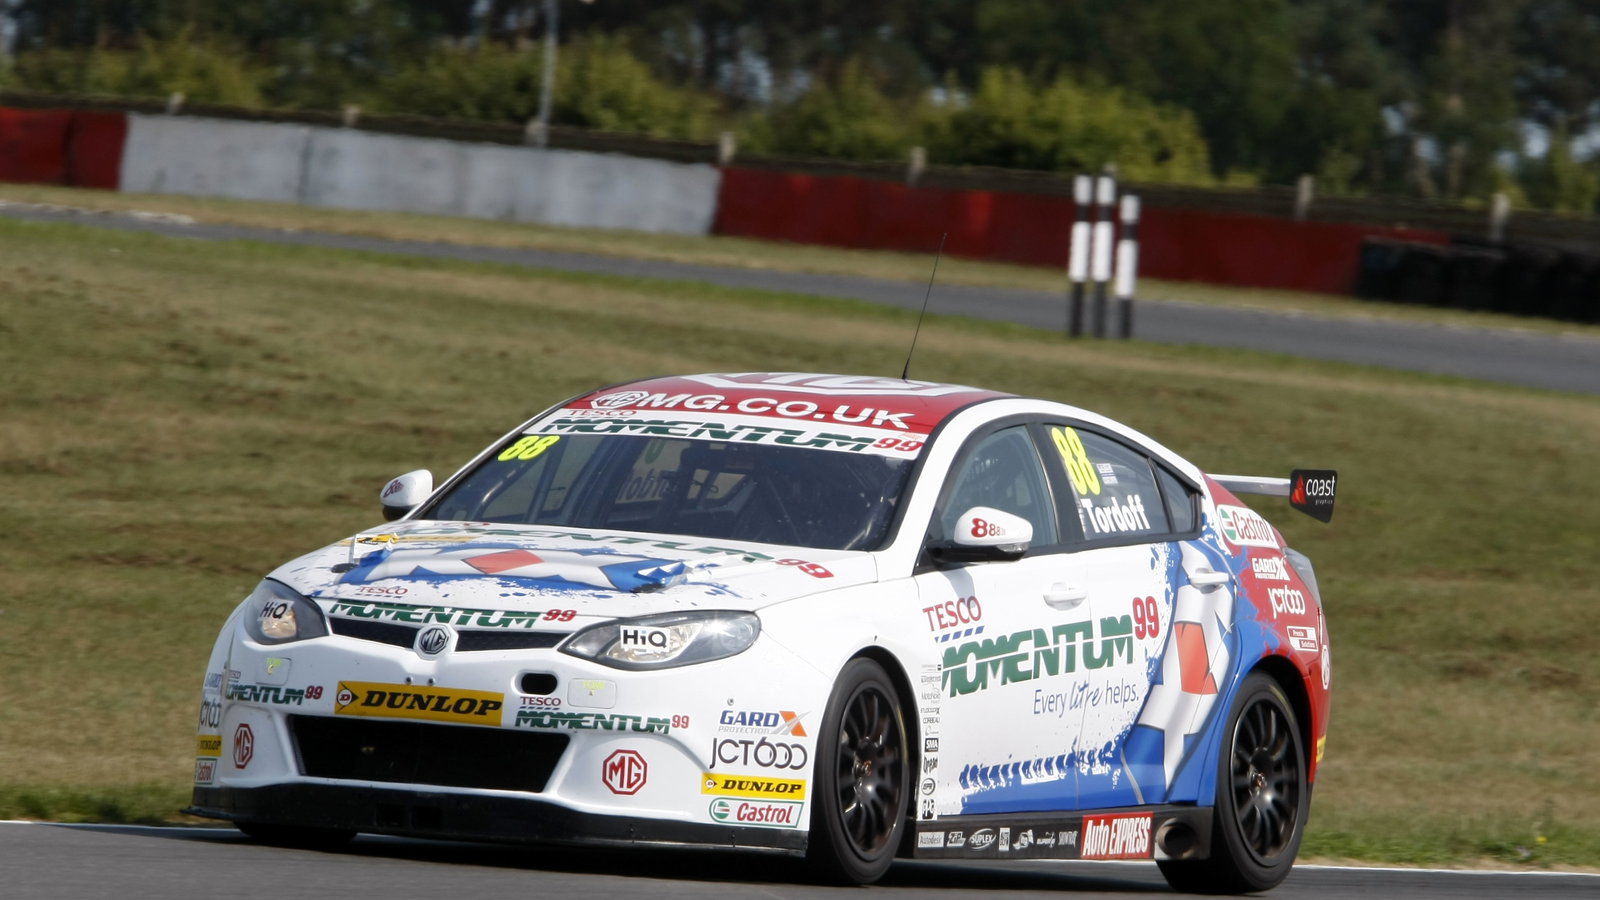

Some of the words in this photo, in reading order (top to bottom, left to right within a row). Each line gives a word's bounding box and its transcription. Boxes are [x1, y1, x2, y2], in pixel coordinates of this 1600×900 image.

[568, 409, 637, 417] TESCO
[640, 393, 916, 429] MG.CO.UK
[498, 435, 560, 461] 88
[539, 418, 877, 452] MOMENTUM
[872, 437, 924, 452] 99
[1051, 426, 1101, 496] 88
[1305, 474, 1336, 497] coast
[1080, 494, 1151, 533] Tordoff
[1232, 510, 1275, 543] Castrol
[357, 586, 409, 595] TESCO
[1267, 585, 1306, 619] JCT600
[260, 601, 288, 620] HiQ
[328, 598, 542, 629] MOMENTUM
[542, 609, 577, 623] 99
[923, 596, 982, 632] TESCO
[420, 628, 448, 653] MG
[622, 629, 668, 649] HiQ
[941, 614, 1133, 698] MOMENTUM
[1132, 596, 1160, 640] 99
[305, 685, 323, 700] 99
[361, 690, 502, 716] DUNLOP
[520, 696, 562, 707] TESCO
[1033, 688, 1067, 718] Every
[1068, 679, 1103, 710] litre
[1104, 677, 1140, 707] helps.
[515, 710, 671, 734] MOMENTUM
[672, 714, 690, 729] 99
[718, 727, 771, 736] PROTECTION
[235, 730, 252, 764] MG
[709, 736, 808, 770] JCT600
[608, 755, 642, 789] MG
[721, 778, 802, 794] DUNLOP
[736, 803, 793, 824] Castrol
[970, 834, 993, 844] SUPLEX
[1083, 819, 1109, 856] Auto
[1109, 817, 1151, 855] EXPRESS
